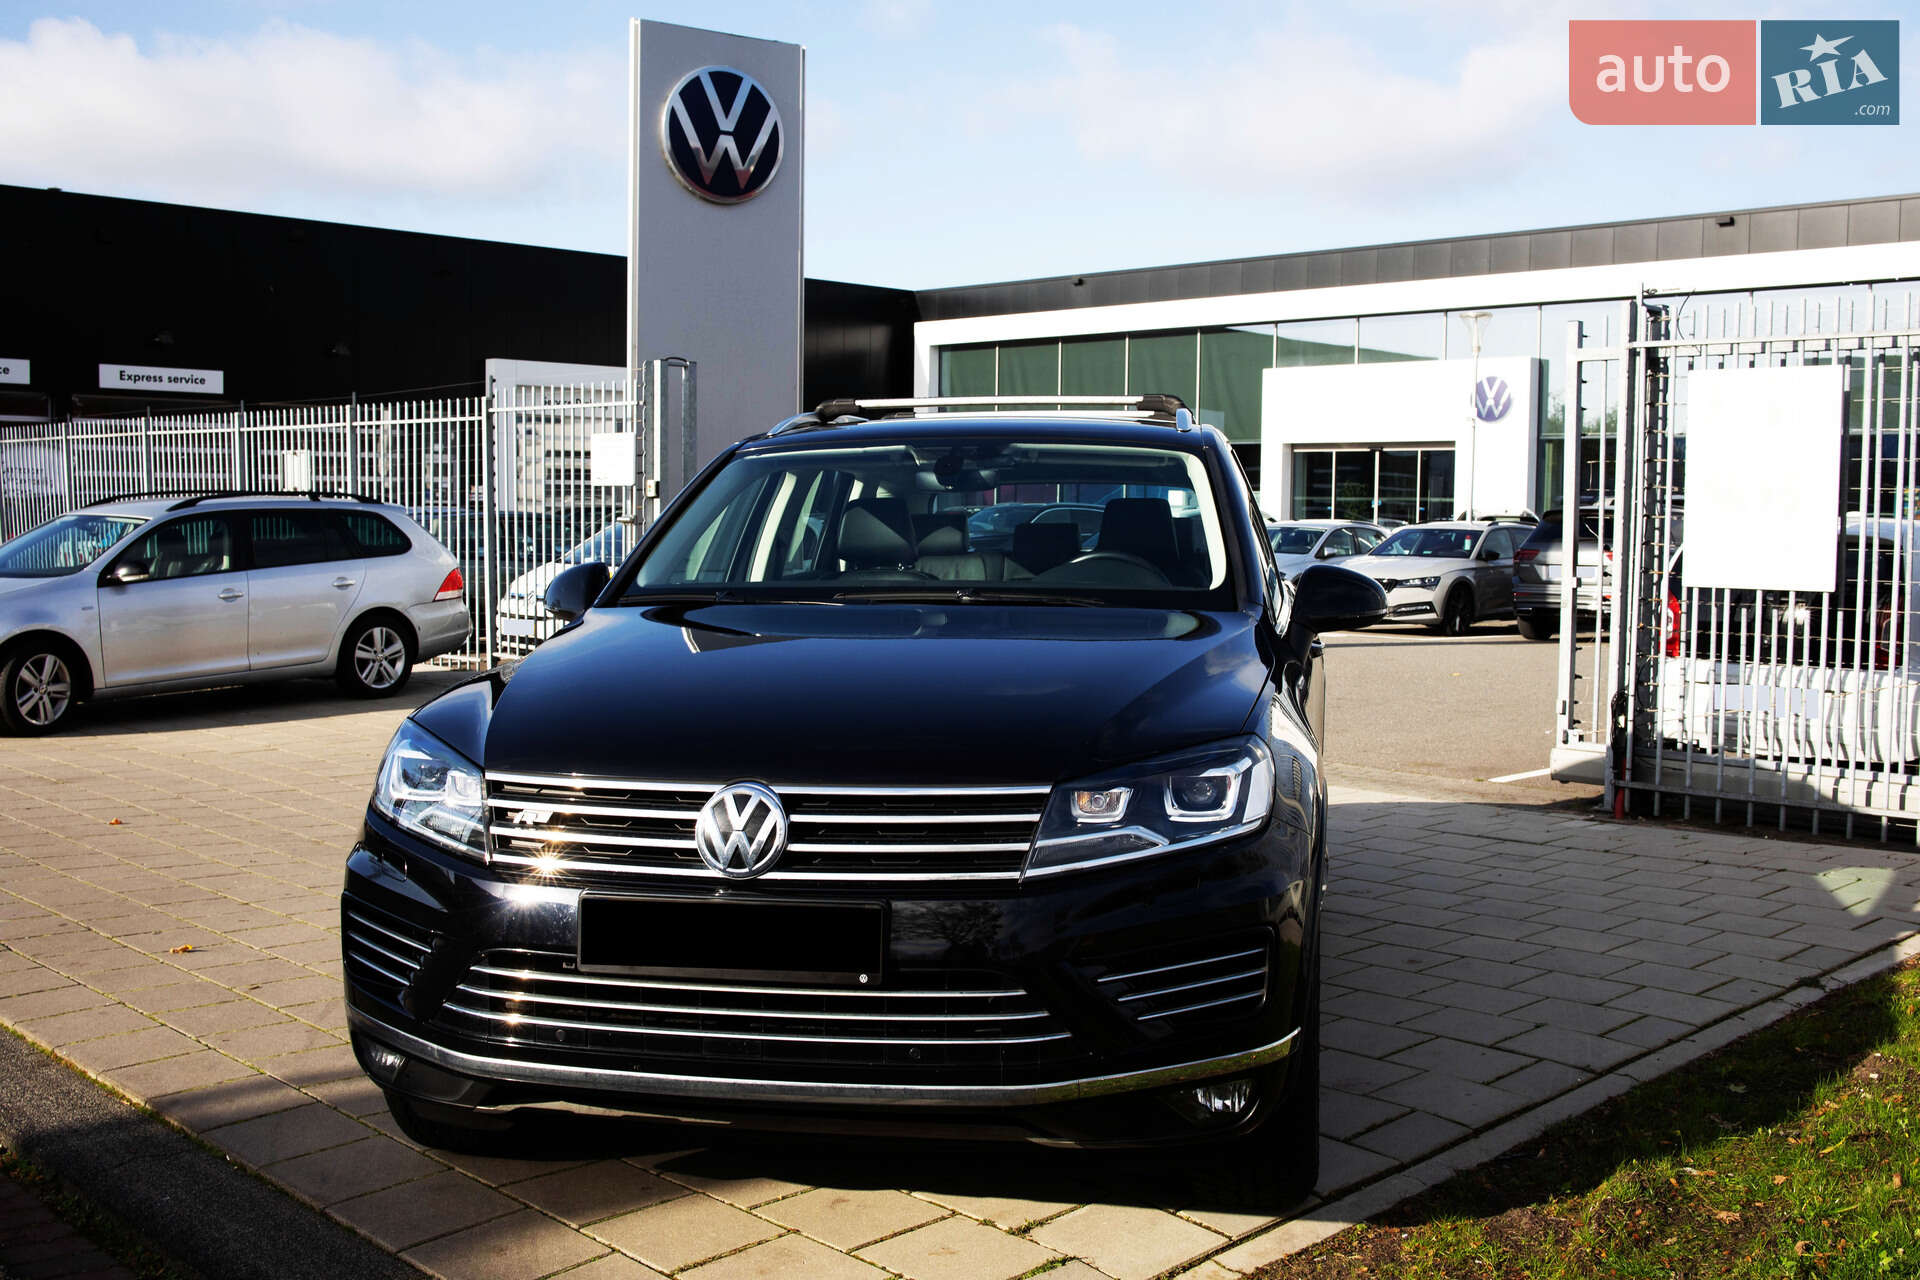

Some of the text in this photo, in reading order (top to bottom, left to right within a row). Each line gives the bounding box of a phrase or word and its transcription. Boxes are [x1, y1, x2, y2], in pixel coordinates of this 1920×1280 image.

[661, 65, 784, 205] VW
[118, 370, 206, 385] Express service
[1471, 375, 1512, 422] VW
[696, 783, 788, 880] VW
